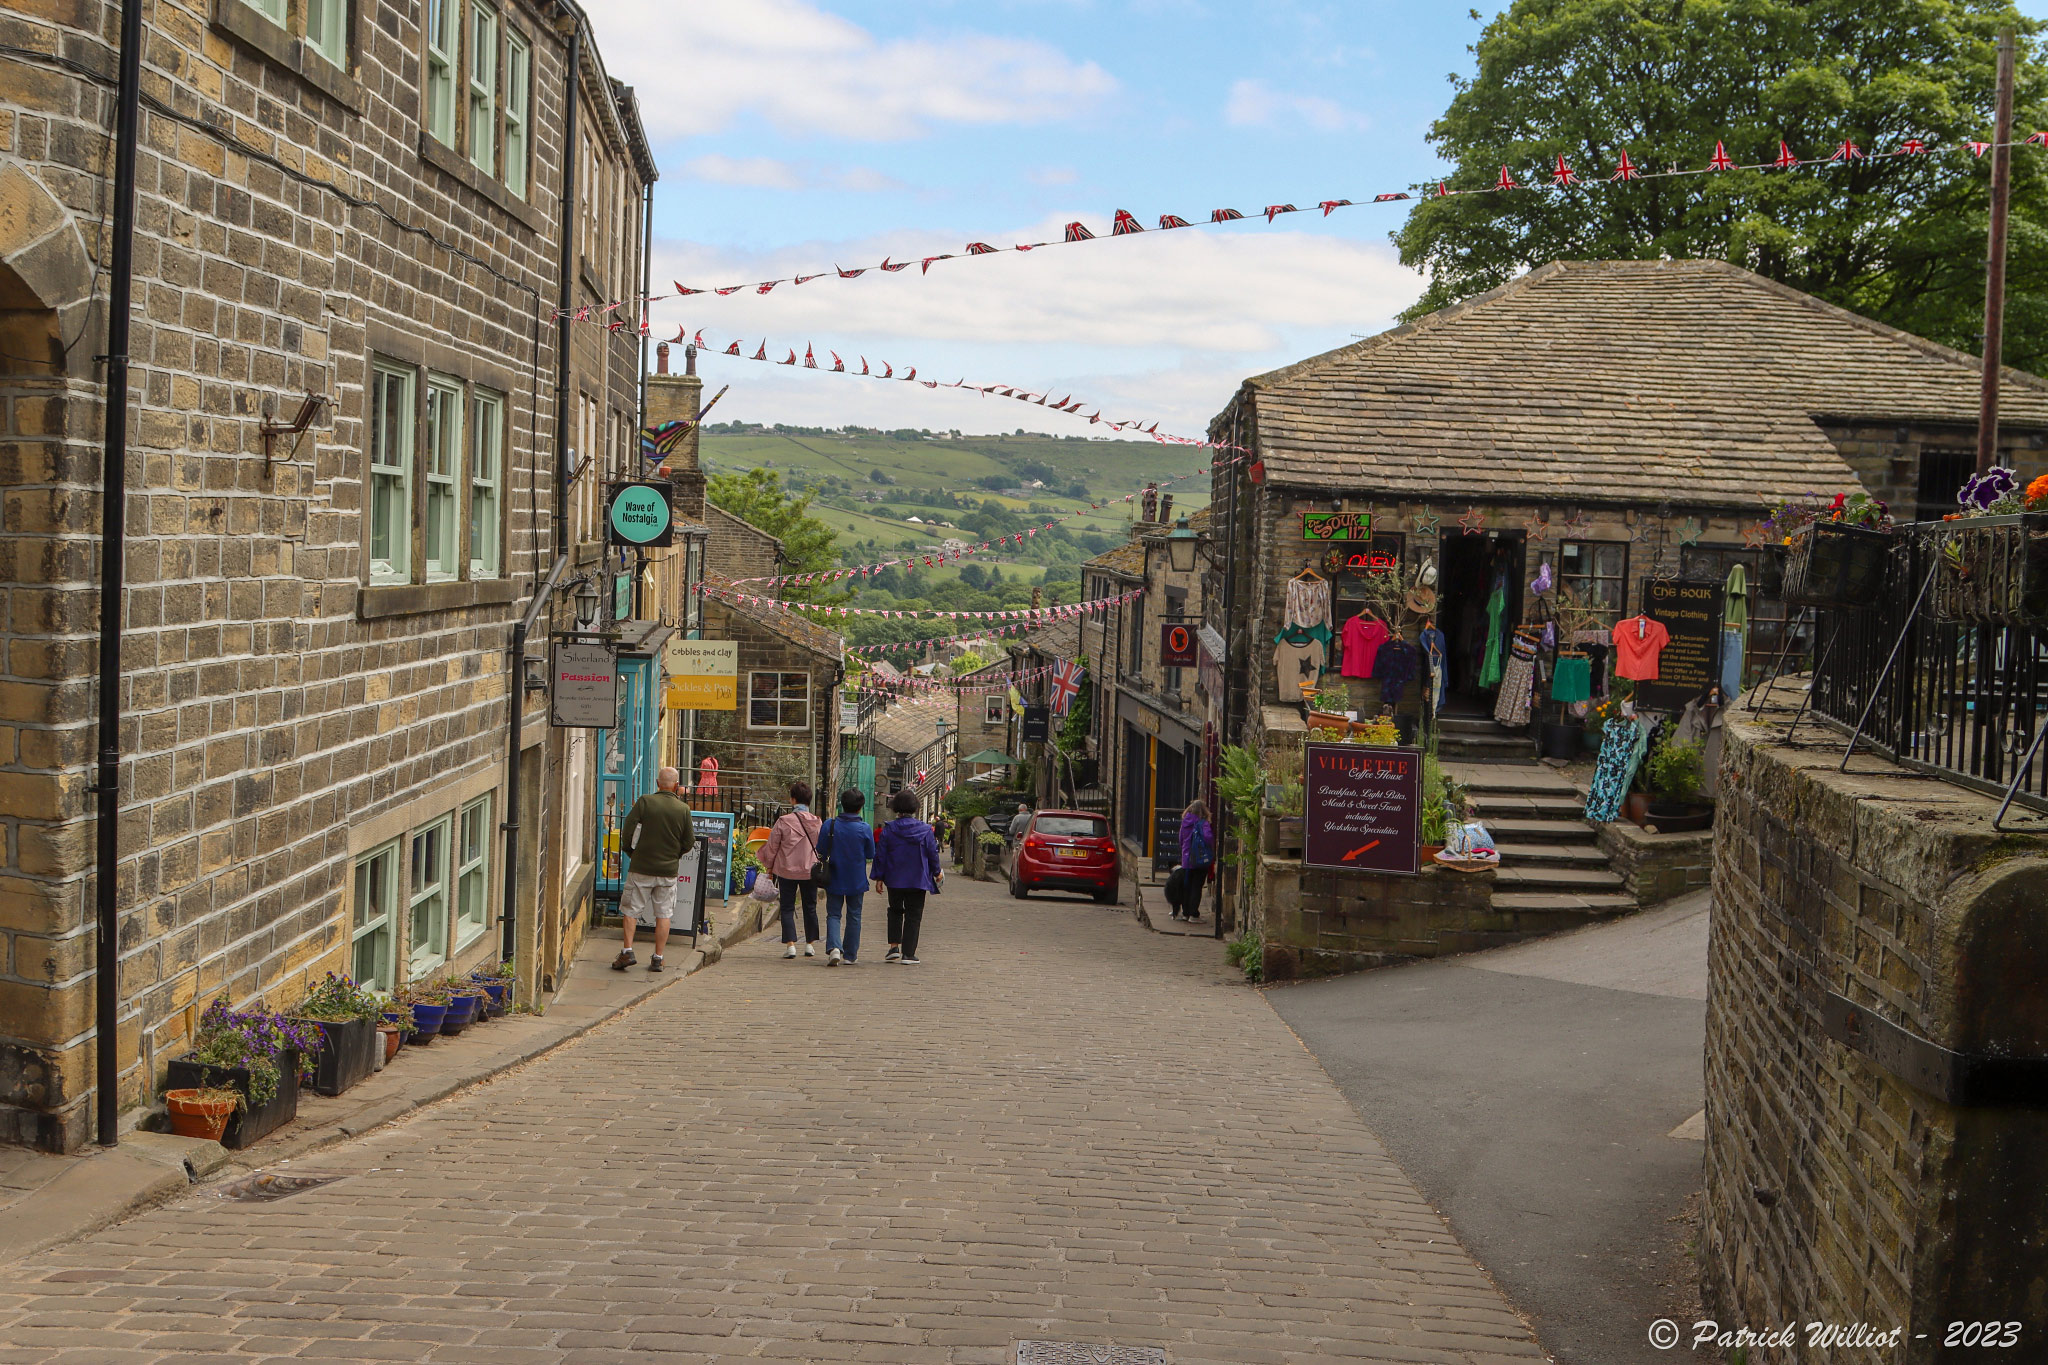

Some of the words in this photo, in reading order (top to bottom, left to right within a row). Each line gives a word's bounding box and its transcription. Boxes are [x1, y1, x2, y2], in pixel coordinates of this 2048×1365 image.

[626, 501, 645, 512] Wave
[647, 501, 656, 512] of
[622, 512, 658, 525] Nostalgia
[1348, 526, 1368, 540] 117
[1348, 554, 1396, 573] OPEN
[1680, 587, 1712, 599] SOUK
[1654, 608, 1679, 618] Vintage
[1680, 609, 1709, 620] Clothing
[1680, 634, 1710, 642] Decorative
[561, 652, 610, 663] Silverland
[671, 647, 701, 656] Cobbles
[702, 648, 716, 656] and
[561, 672, 610, 682] Passion
[703, 681, 712, 693] &
[1319, 756, 1408, 775] VILLETTE
[1348, 767, 1374, 780] Coffee
[1374, 769, 1404, 781] House
[1360, 788, 1383, 800] Light
[1383, 790, 1407, 800] Bites,
[1321, 798, 1346, 808] Meals
[1346, 800, 1355, 808] &
[1355, 799, 1377, 810] Sweet
[1378, 801, 1402, 812] Treats
[1344, 812, 1377, 823] including
[705, 819, 726, 830] Nostalgia
[1323, 820, 1359, 832] Yorkshire
[1359, 823, 1399, 836] Specialities
